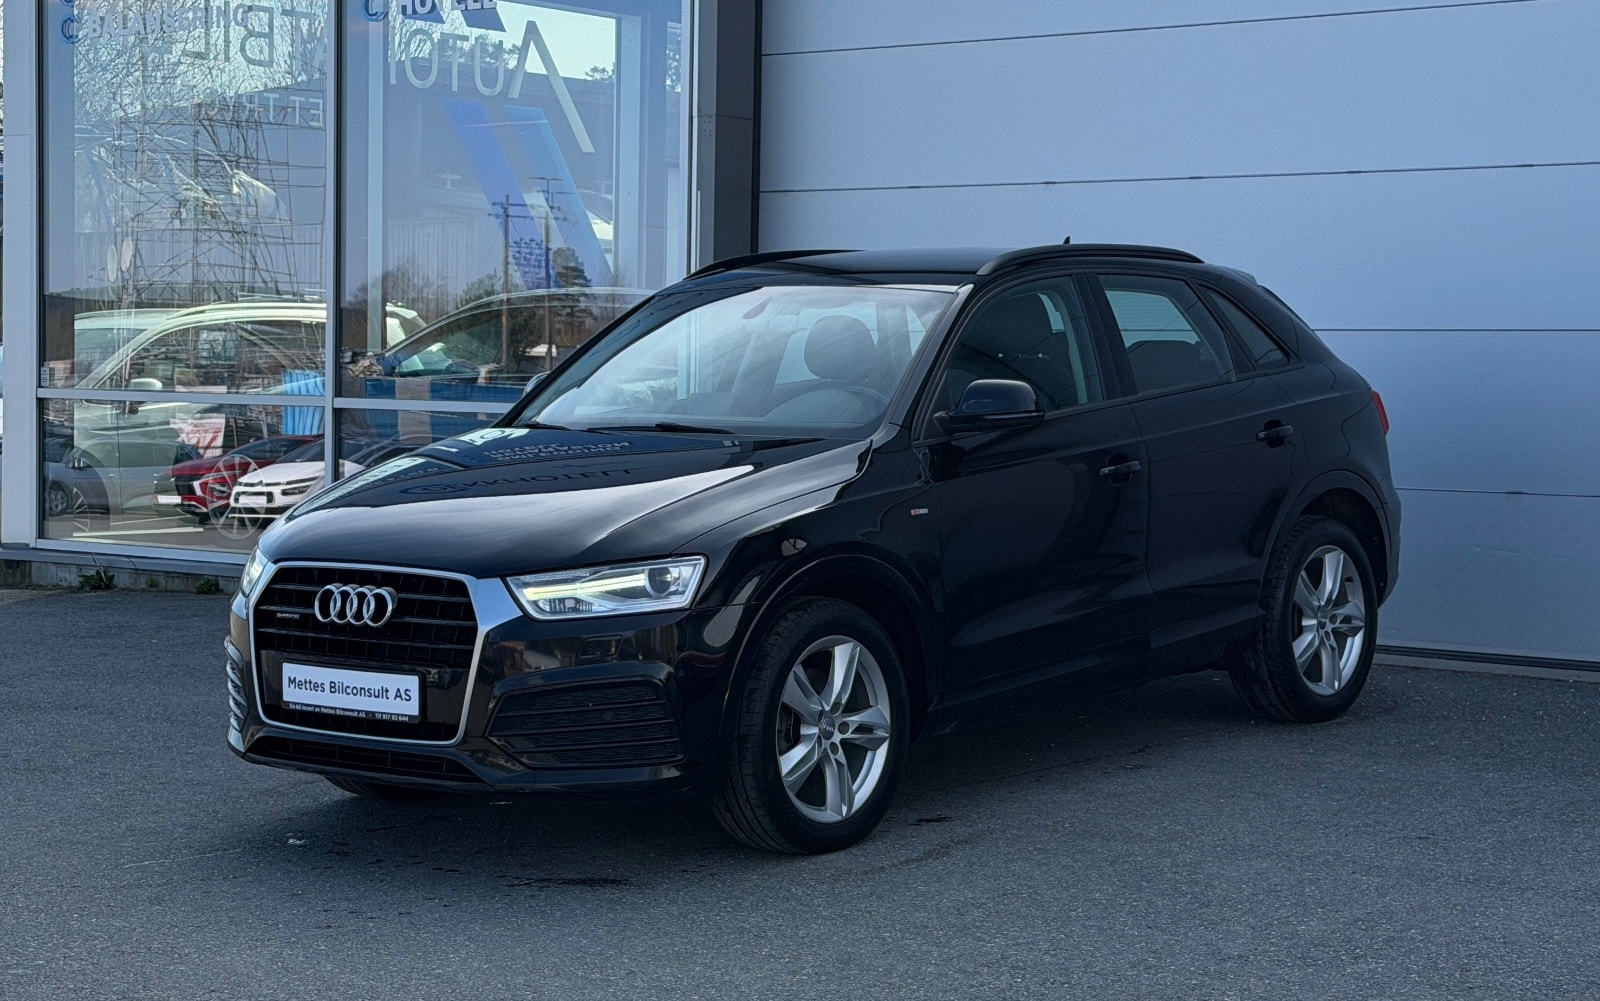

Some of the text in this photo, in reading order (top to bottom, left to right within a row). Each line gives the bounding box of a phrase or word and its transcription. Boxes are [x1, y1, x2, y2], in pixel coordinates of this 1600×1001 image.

[88, 3, 249, 38] BALANSERING
[288, 676, 412, 702] Mettes Bilconsult AS
[321, 707, 336, 715] Mettes
[336, 709, 358, 718] Bilconsult
